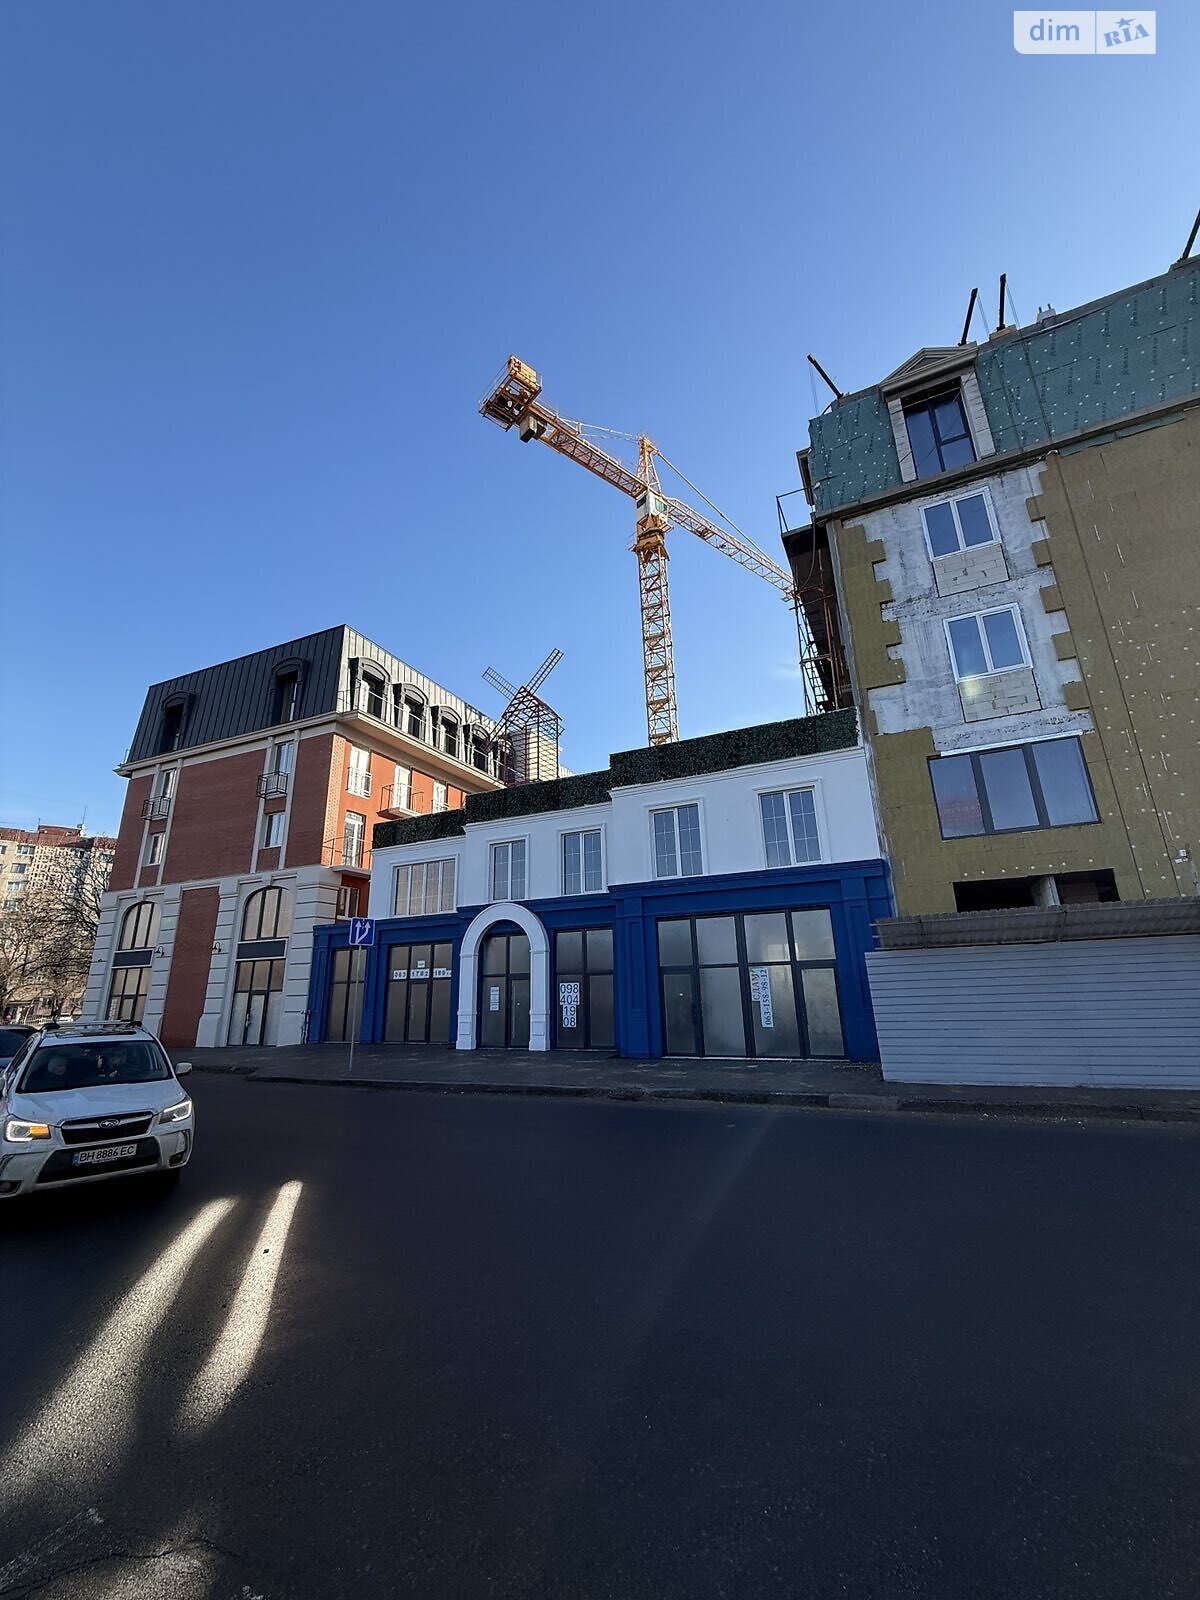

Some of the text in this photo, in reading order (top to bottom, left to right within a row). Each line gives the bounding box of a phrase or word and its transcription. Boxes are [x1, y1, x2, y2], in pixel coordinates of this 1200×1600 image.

[559, 984, 579, 994] 098
[559, 995, 579, 1005] 404
[760, 969, 772, 1026] 063-158-98-12
[564, 1006, 576, 1016] 19
[563, 1017, 576, 1027] 08
[79, 1151, 95, 1162] BH
[96, 1148, 119, 1159] 8886
[120, 1145, 135, 1155] EC
